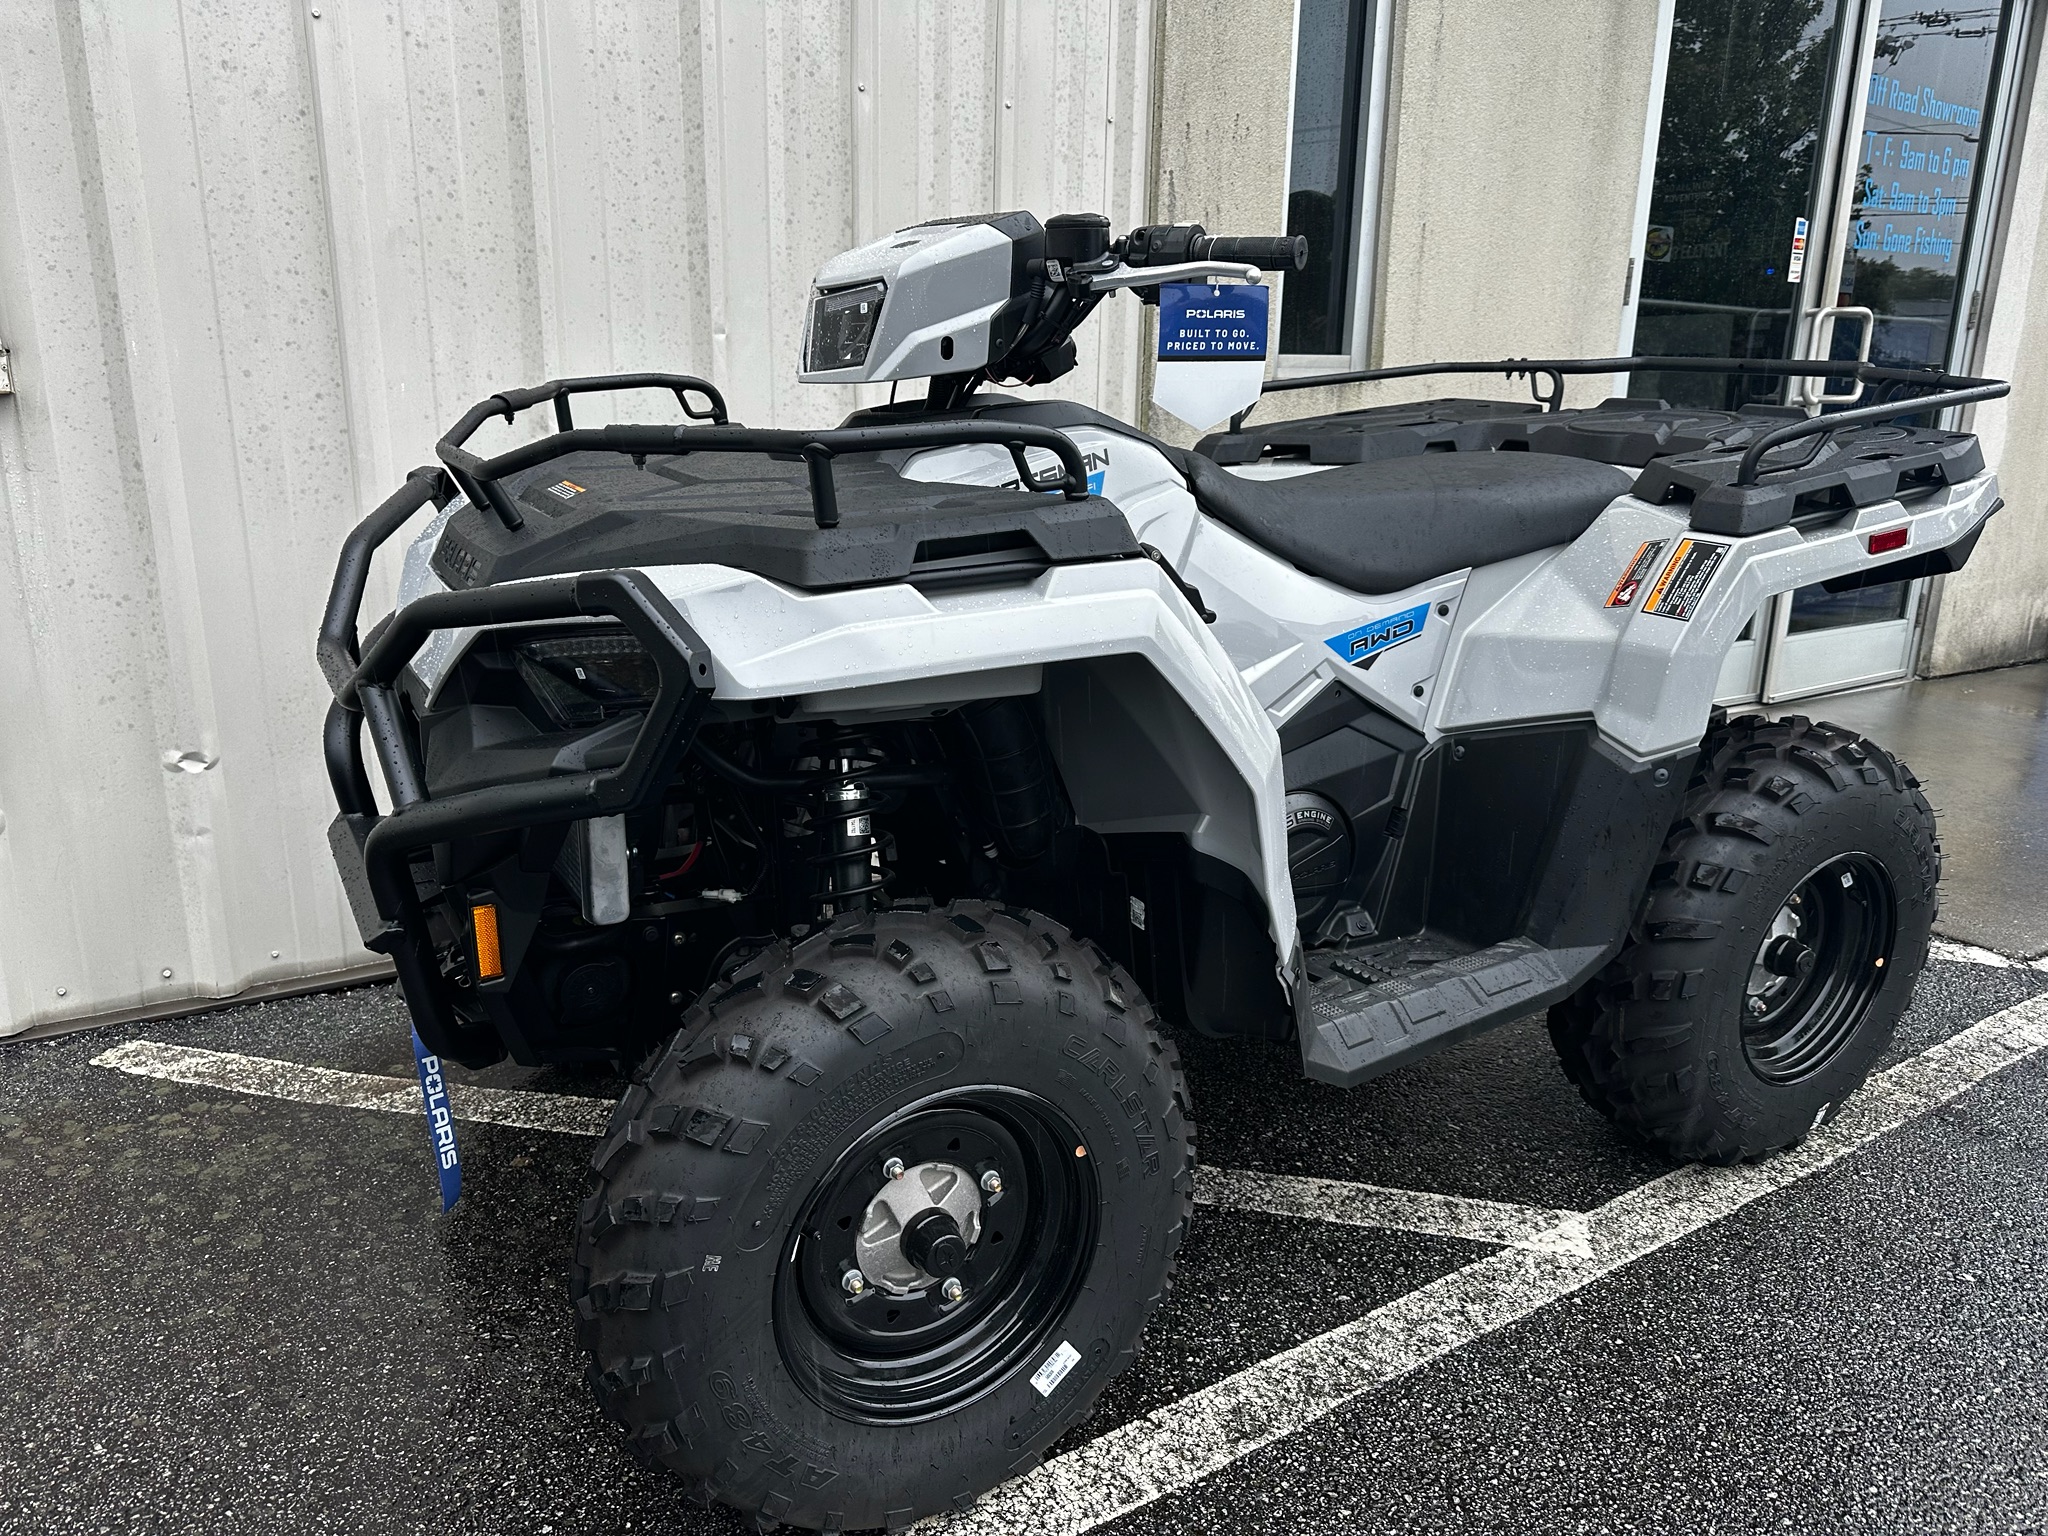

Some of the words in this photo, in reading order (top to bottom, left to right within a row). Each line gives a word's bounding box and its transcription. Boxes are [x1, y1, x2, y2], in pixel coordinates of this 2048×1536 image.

[1868, 74, 1889, 107] Off
[1888, 80, 1920, 114] Road
[1920, 87, 1980, 128] Showroom
[1866, 131, 1878, 164] T
[1883, 137, 1894, 167] F:
[1900, 140, 1925, 172] 9am
[1928, 149, 1940, 174] to
[1942, 147, 1952, 175] 6
[1951, 158, 1970, 182] pm
[1862, 177, 1887, 209] Sat:
[1889, 182, 1915, 212] 9am
[1917, 190, 1929, 214] to
[1932, 187, 1957, 221] 3pm
[1854, 220, 1880, 250] Sun:
[1882, 223, 1912, 253] Gone
[1914, 227, 1953, 262] Fishing
[1179, 329, 1211, 338] BUILT
[1215, 329, 1228, 338] TO
[1232, 329, 1249, 338] GO.
[1186, 309, 1245, 319] POLARIS
[1166, 342, 1206, 350] PRICED
[1211, 342, 1223, 350] TO
[1227, 342, 1260, 350] MOVE.
[1659, 556, 1682, 589] WARNING
[1347, 630, 1362, 640] ON
[1366, 611, 1415, 633] DEMAND
[1349, 619, 1415, 657] AWD
[1296, 810, 1332, 824] ENGINE
[421, 1055, 458, 1170] POLARIS
[1060, 1032, 1161, 1180] CARLSTAR
[708, 1368, 840, 1489] AT489
